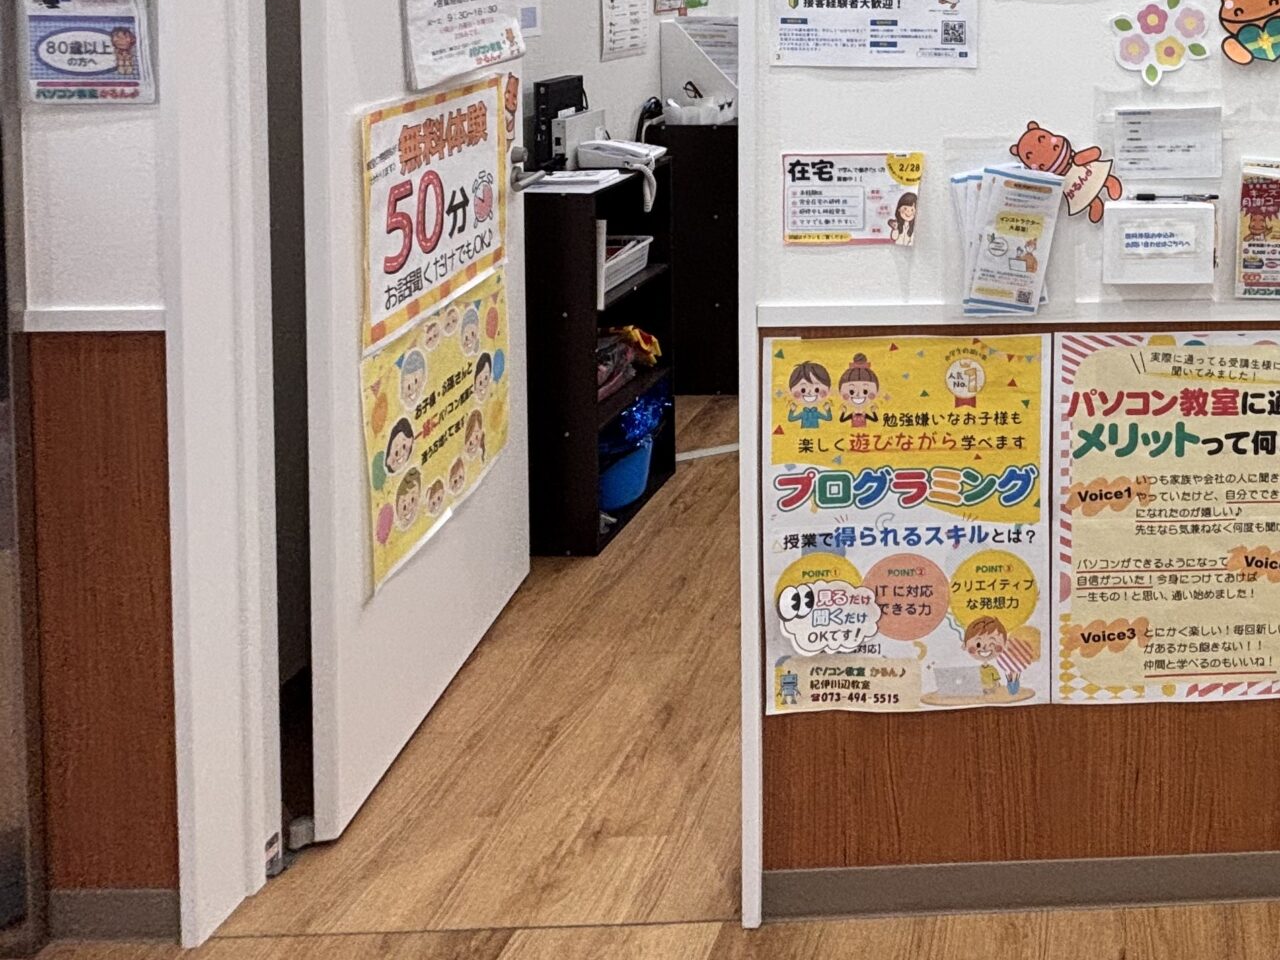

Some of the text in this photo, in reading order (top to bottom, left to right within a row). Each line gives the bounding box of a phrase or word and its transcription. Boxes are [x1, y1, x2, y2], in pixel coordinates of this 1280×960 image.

[45, 39, 114, 57] 80歳以上
[66, 55, 98, 68] の方へ
[397, 100, 489, 176] 無料体験
[788, 159, 835, 183] 在宅
[898, 163, 921, 173] 2/28
[1065, 164, 1093, 201] かるん♪
[383, 169, 470, 275] 50分
[384, 229, 493, 311] お話聞くだけでもOK♪
[1171, 365, 1257, 382] 聞いてみました！
[882, 410, 1023, 427] 勉強嫌いなお子様も
[798, 431, 1027, 453] 楽しく遊びながら学べます
[773, 463, 1040, 512] プログラミング
[1077, 485, 1133, 503] Voice1
[1135, 506, 1243, 519] になれたのが嬉しい♪
[783, 524, 1037, 550] 授業で得られるスキルとは？
[1076, 555, 1228, 570] パソコンができるようになって
[950, 578, 1035, 592] クリエイティブ
[816, 589, 872, 606] 見るだけ
[966, 596, 1020, 611] な発想力
[1076, 588, 1255, 602] 一生もの！と思い、通い始めました！
[811, 608, 867, 627] 聞くだけ
[807, 628, 861, 644] OKです！
[1080, 627, 1137, 644] Voice3
[1143, 640, 1263, 654] があるから飽きない！！
[810, 665, 907, 678] パソコン教室 かるん♪
[1143, 656, 1274, 671] 仲間と学べるのもいいね！
[809, 678, 871, 691] 紀伊川辺教室
[820, 691, 900, 704] 073-494-5515
